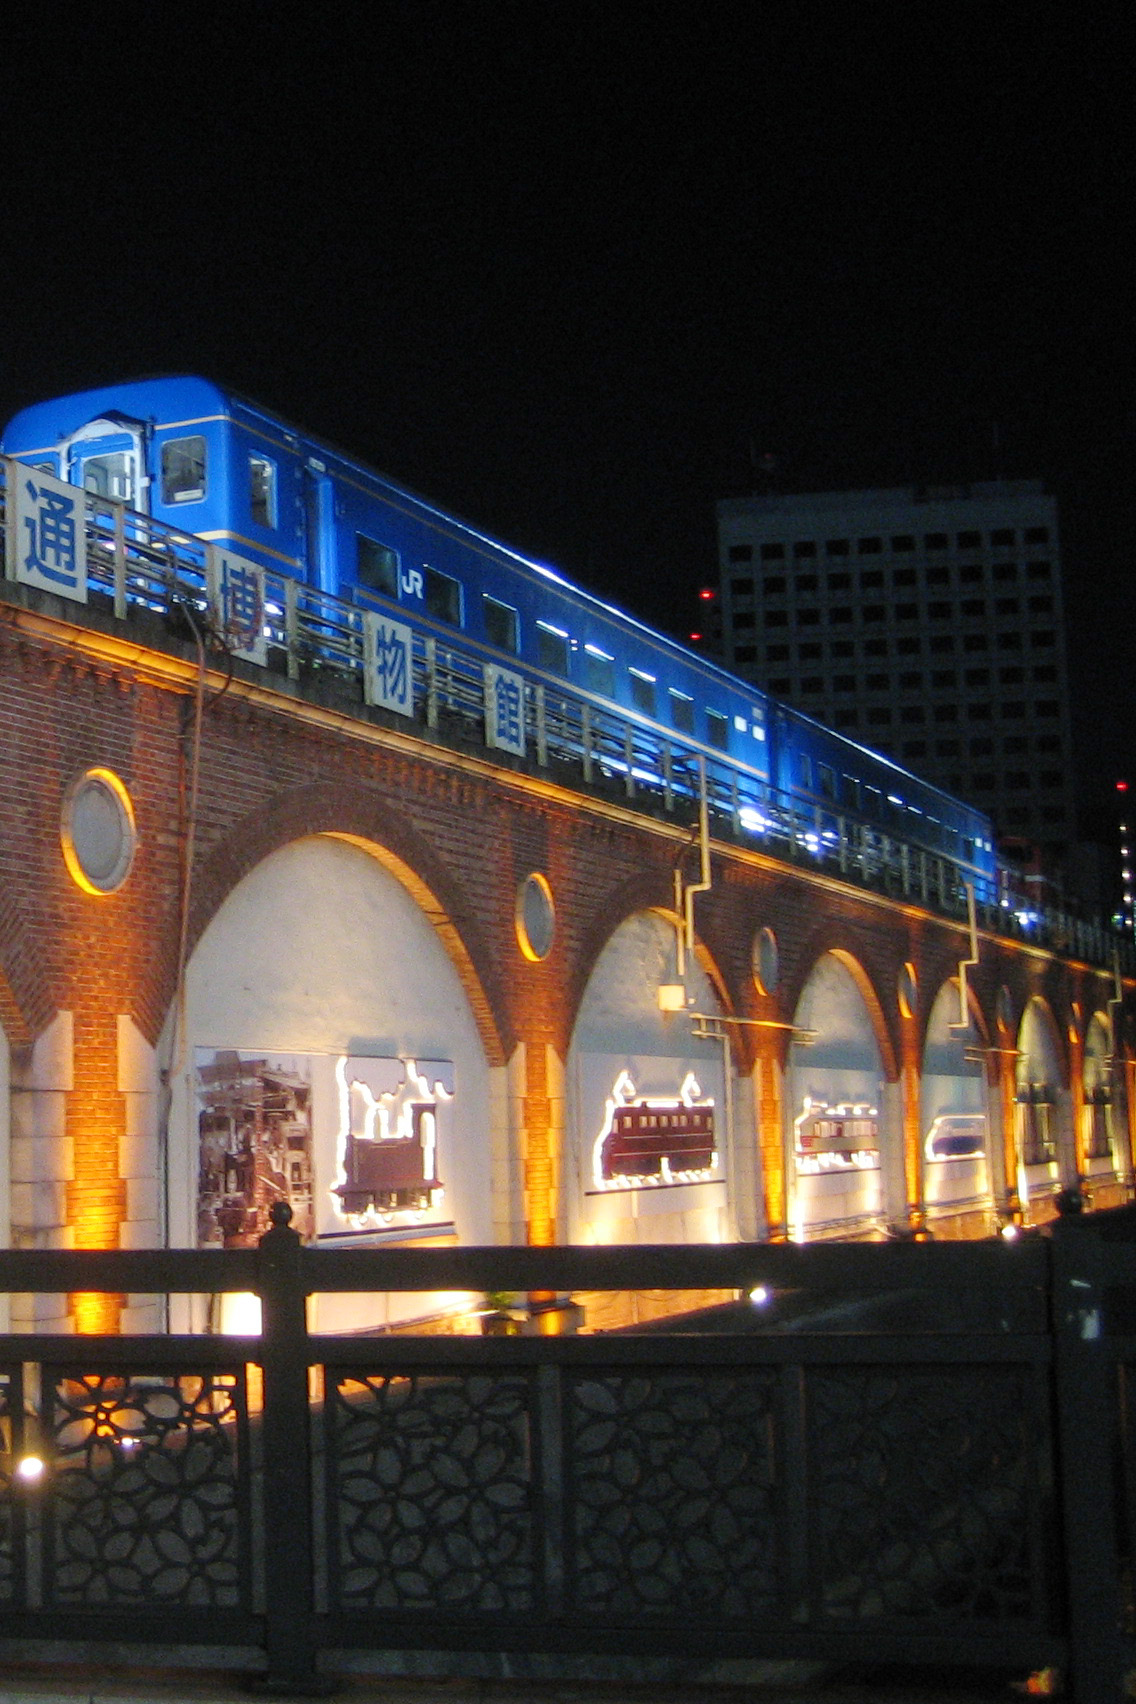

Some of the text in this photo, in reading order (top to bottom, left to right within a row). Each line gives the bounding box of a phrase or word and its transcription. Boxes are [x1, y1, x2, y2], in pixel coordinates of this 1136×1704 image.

[24, 480, 78, 588] 通
[376, 624, 407, 706] 物
[495, 673, 521, 749] 館
[402, 569, 424, 600] JR
